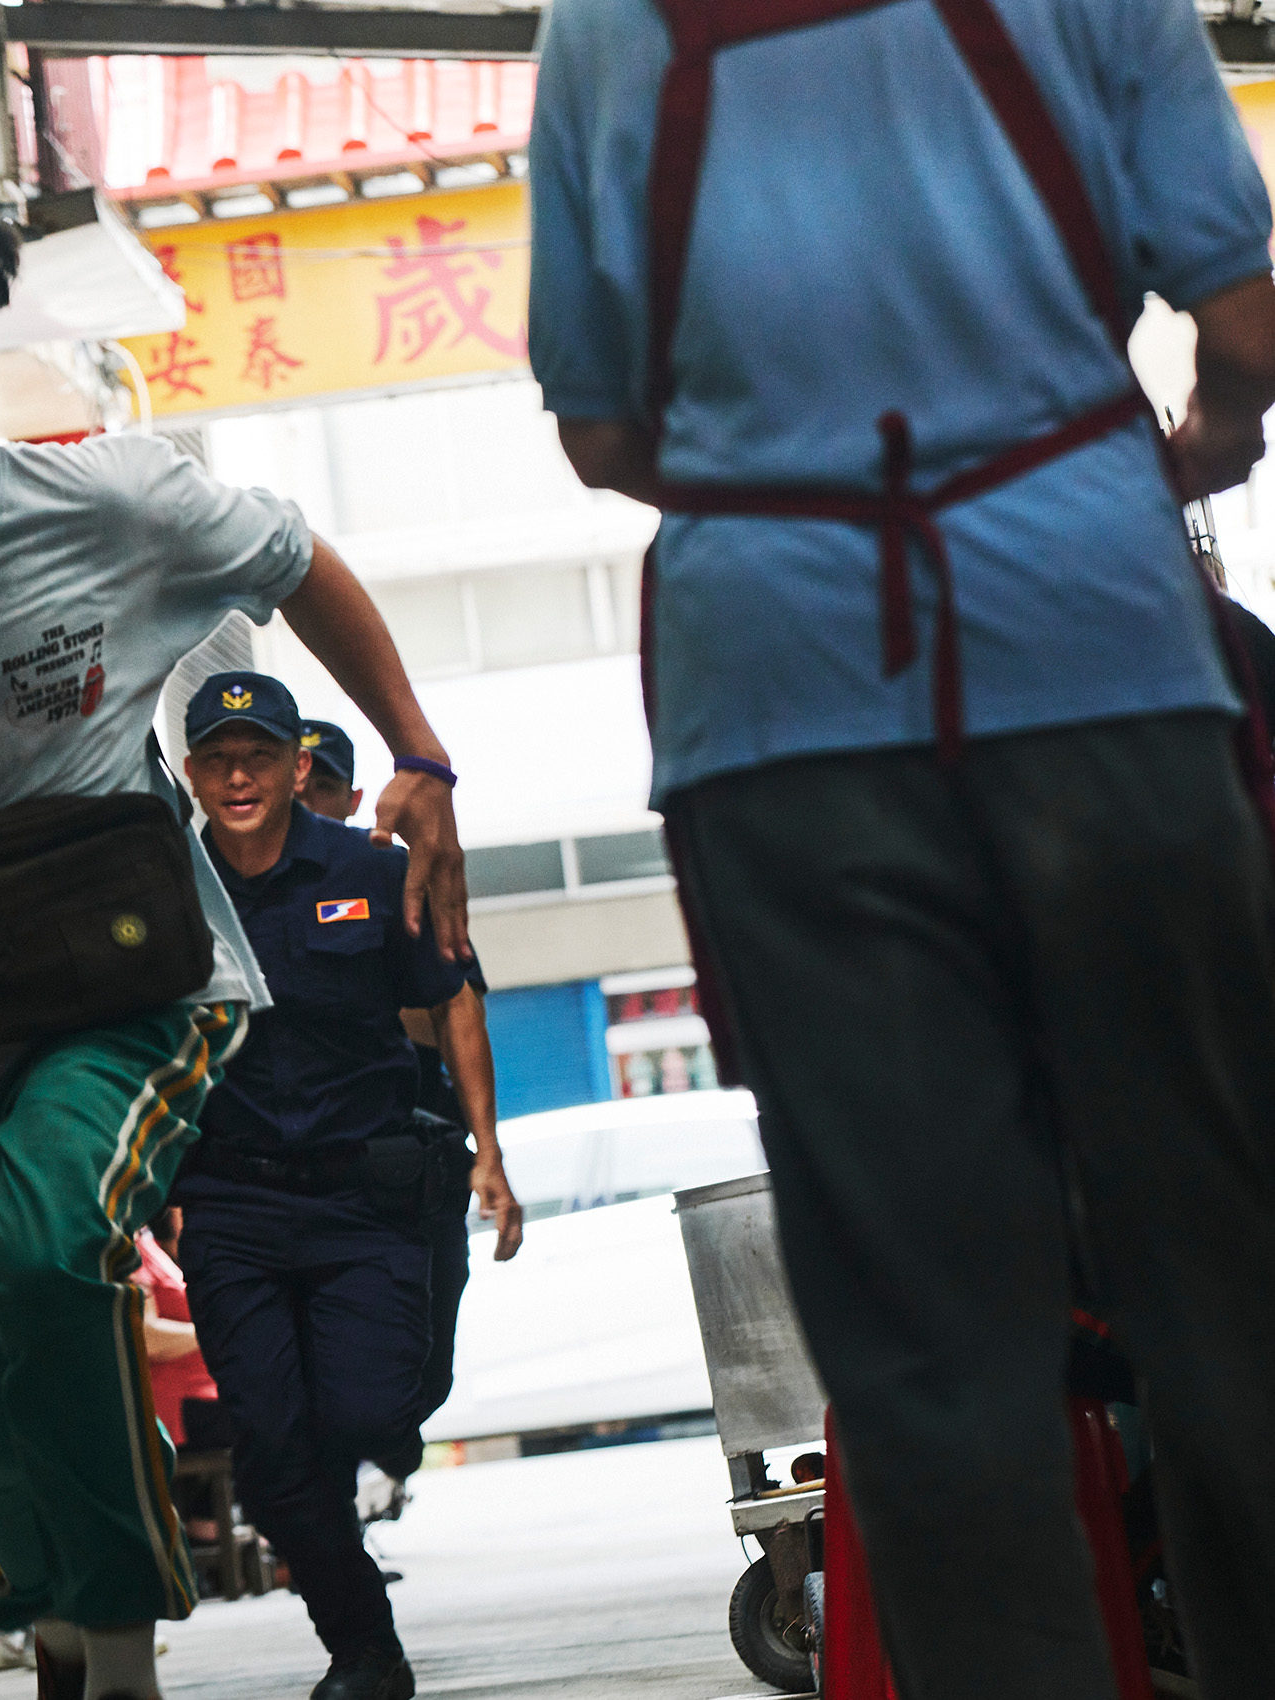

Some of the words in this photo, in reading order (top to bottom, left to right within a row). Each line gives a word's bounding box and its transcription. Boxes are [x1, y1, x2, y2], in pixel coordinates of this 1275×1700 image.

[373, 214, 528, 366] 歲
[1, 640, 60, 675] ROLLING
[63, 621, 104, 649] STONES
[42, 624, 66, 642] THE
[36, 648, 85, 676] PRESENTS
